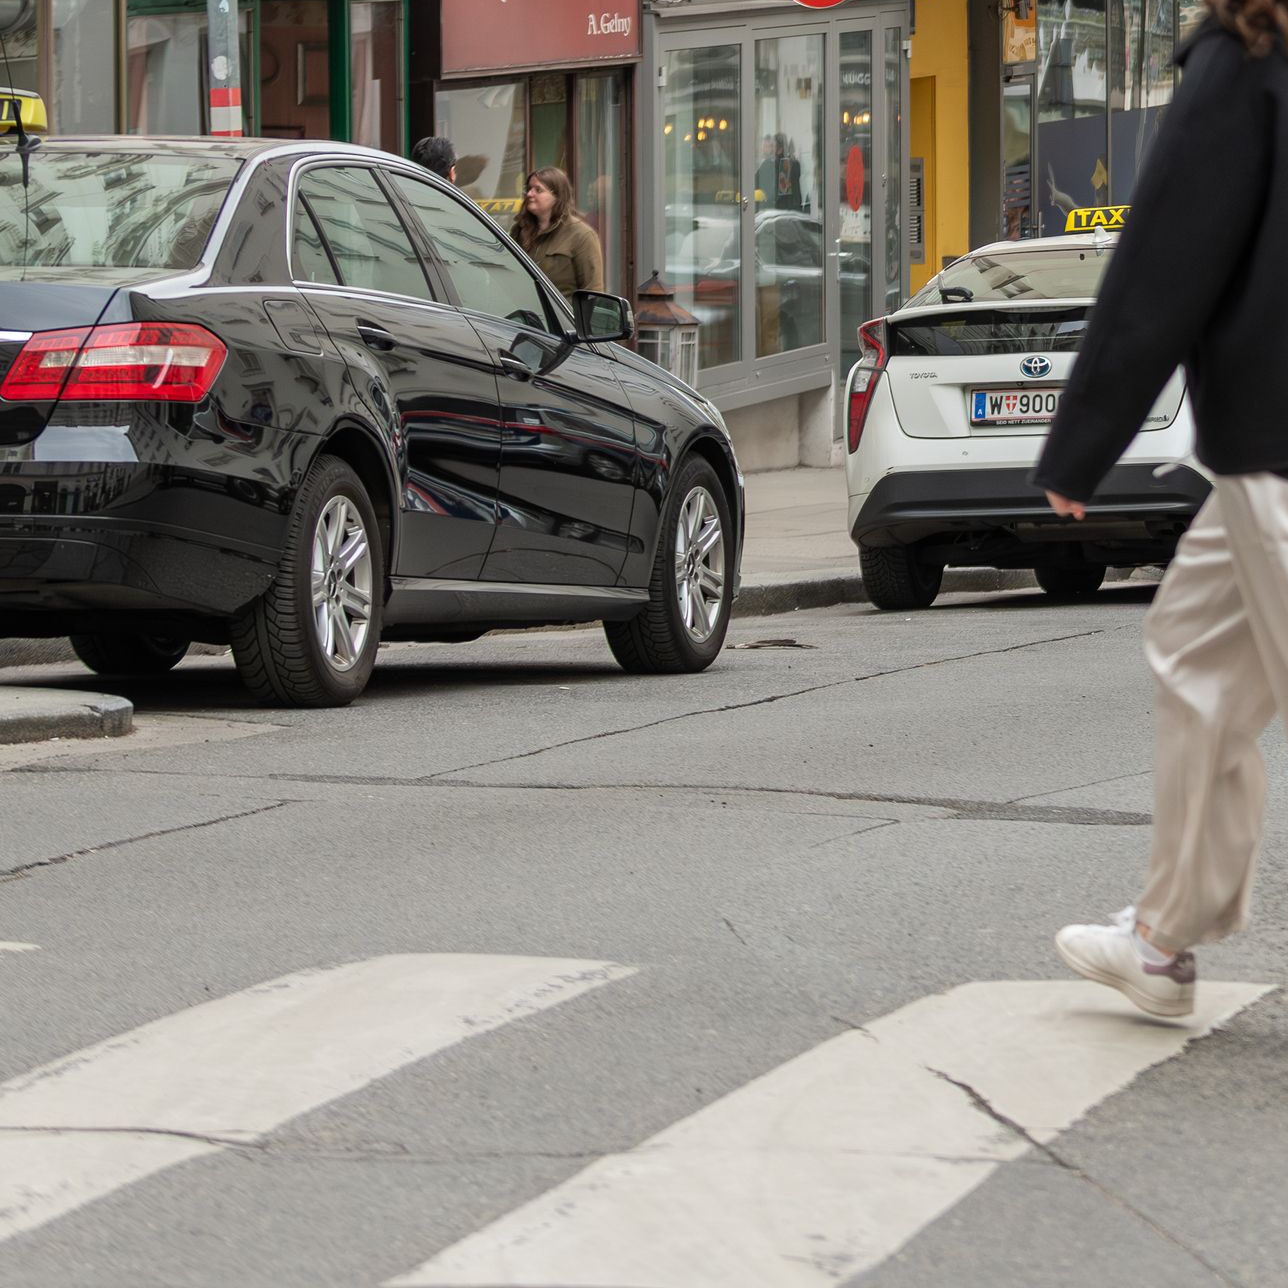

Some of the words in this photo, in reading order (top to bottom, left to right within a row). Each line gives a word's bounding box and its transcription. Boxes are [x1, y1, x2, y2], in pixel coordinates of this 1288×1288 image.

[1077, 208, 1130, 228] TAX
[989, 395, 1004, 415] W
[1019, 393, 1058, 414] 900
